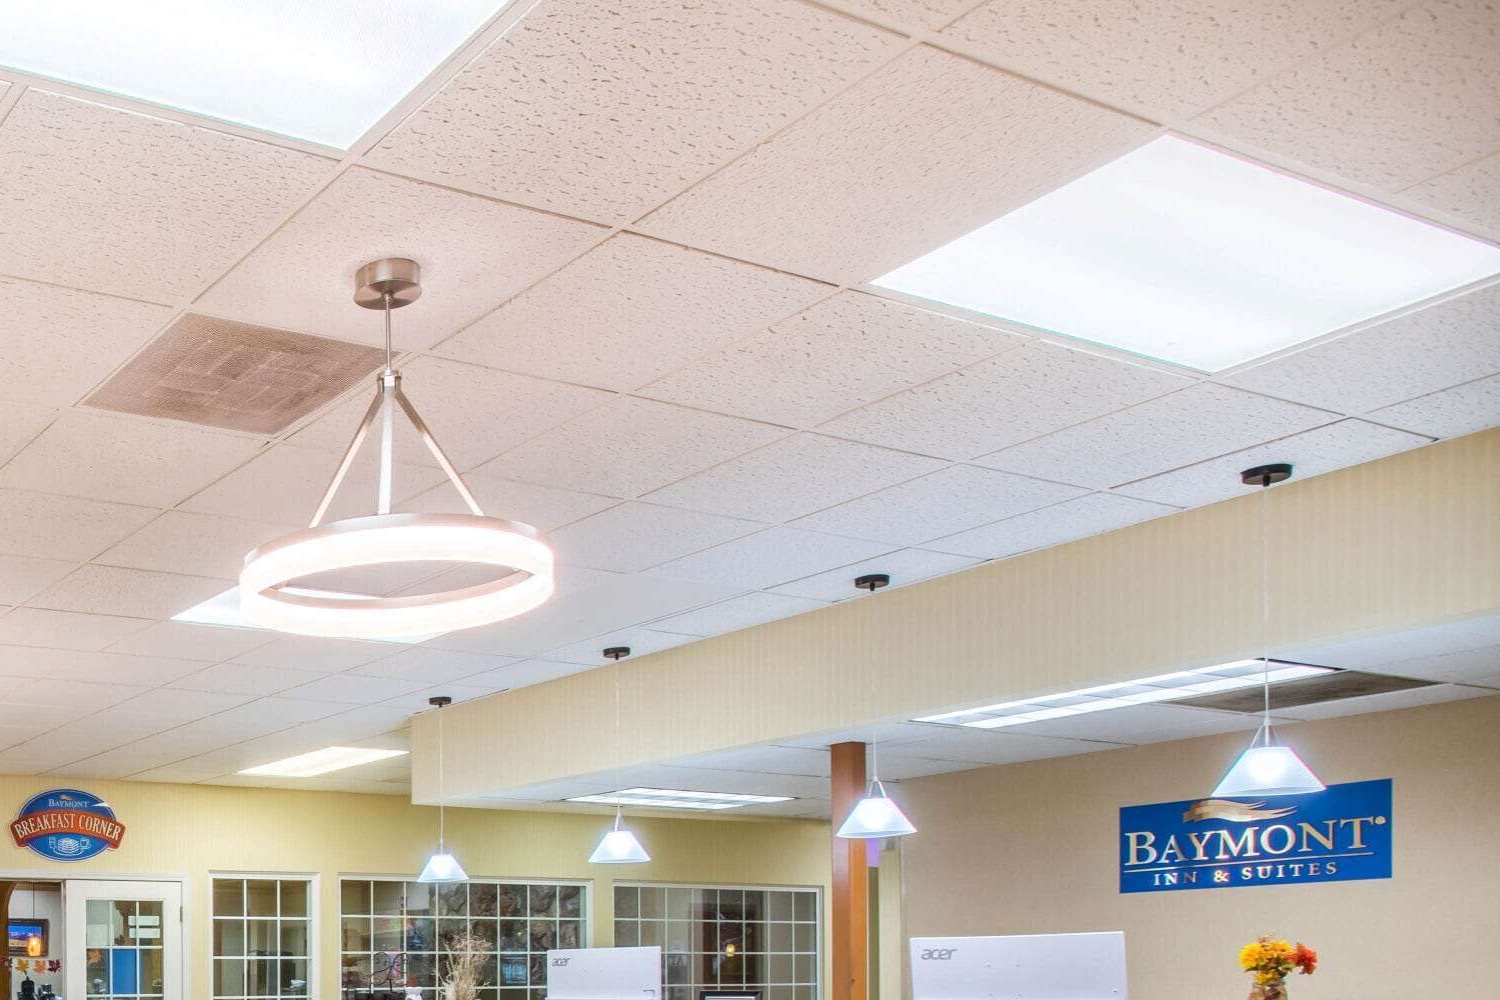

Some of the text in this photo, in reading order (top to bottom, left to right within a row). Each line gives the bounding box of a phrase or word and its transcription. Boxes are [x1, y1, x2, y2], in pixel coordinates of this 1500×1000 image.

[48, 798, 90, 808] BAYMONT
[14, 813, 121, 841] BREAKFAST CORNER
[1124, 816, 1375, 866] BAYMONT
[1153, 861, 1338, 887] INN & SUITES
[551, 957, 572, 967] acer
[921, 948, 958, 961] acer
